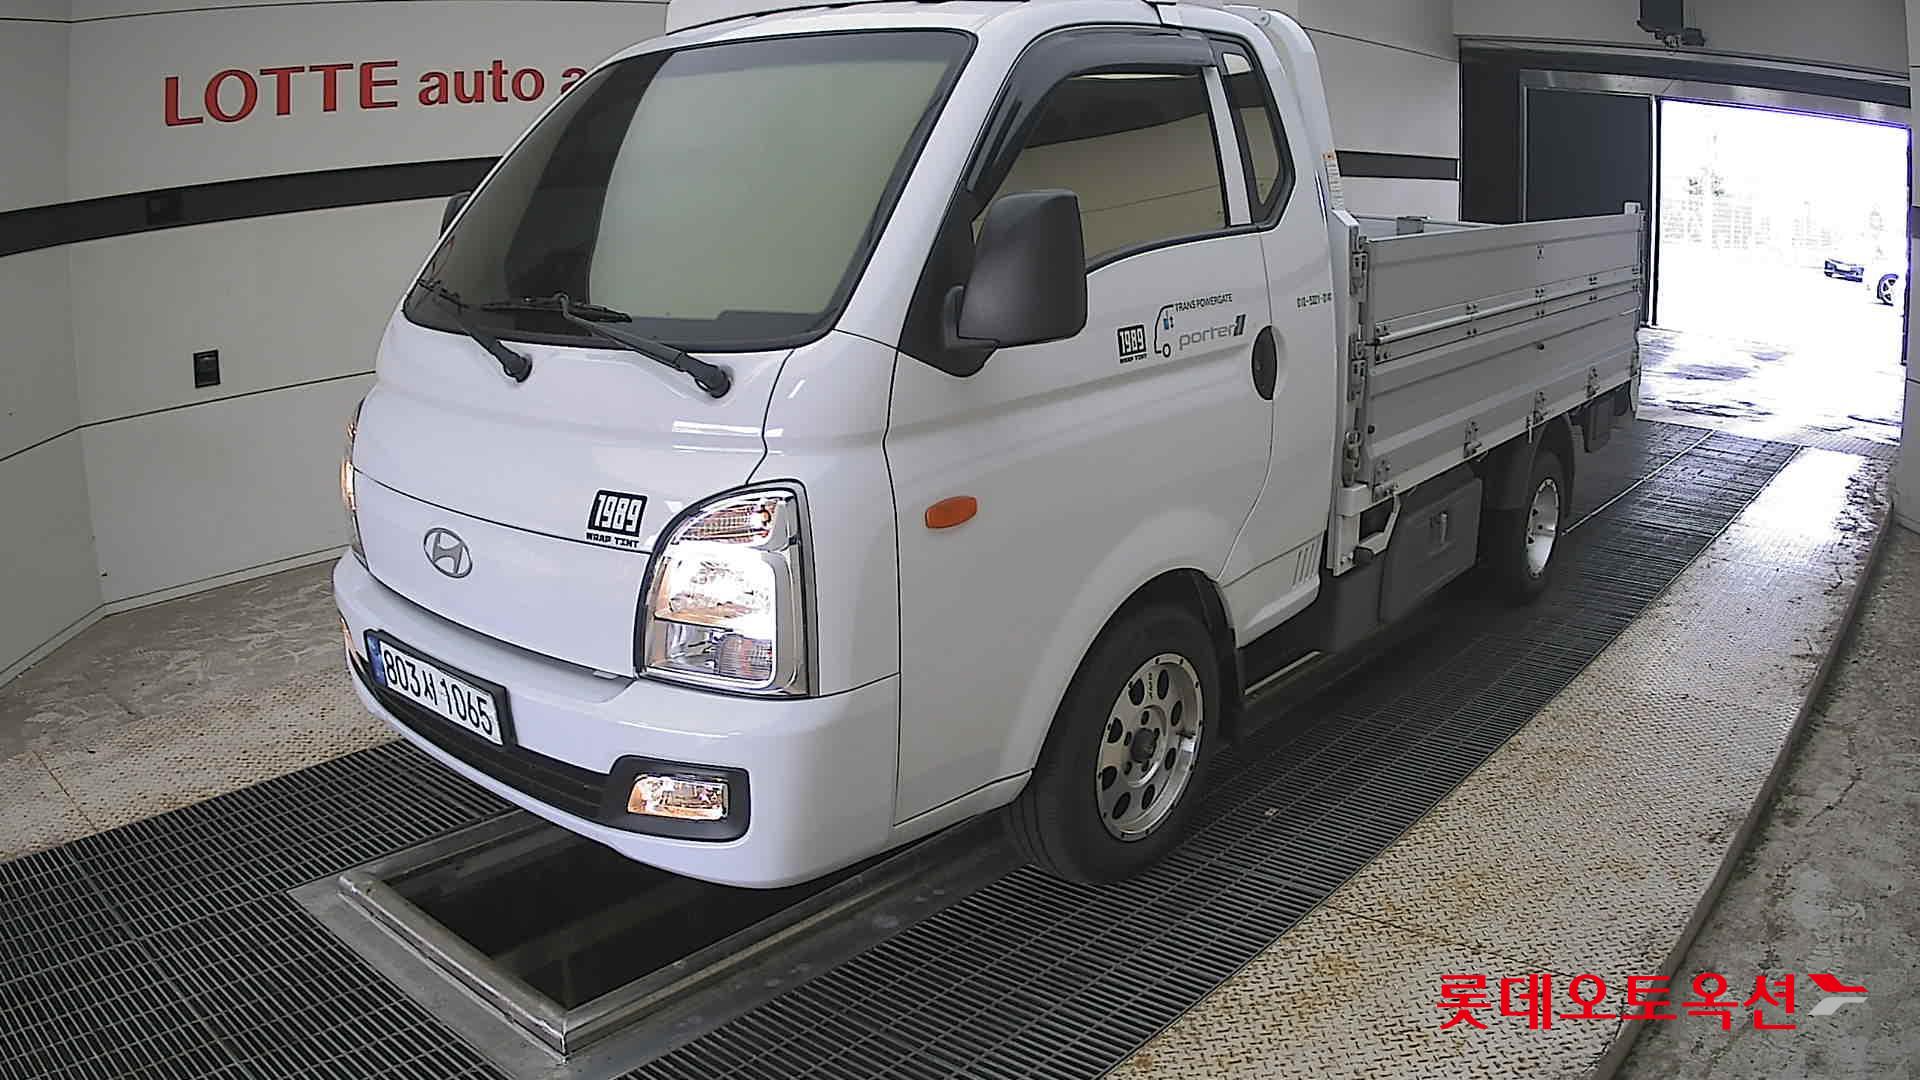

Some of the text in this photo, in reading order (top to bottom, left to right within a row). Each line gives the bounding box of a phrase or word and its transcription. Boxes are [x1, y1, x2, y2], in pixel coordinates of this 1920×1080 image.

[165, 60, 399, 126] LOTTE
[417, 60, 545, 106] auto
[1120, 328, 1144, 354] 1989
[594, 494, 643, 533] 1989
[586, 532, 639, 548] WRAP TINT
